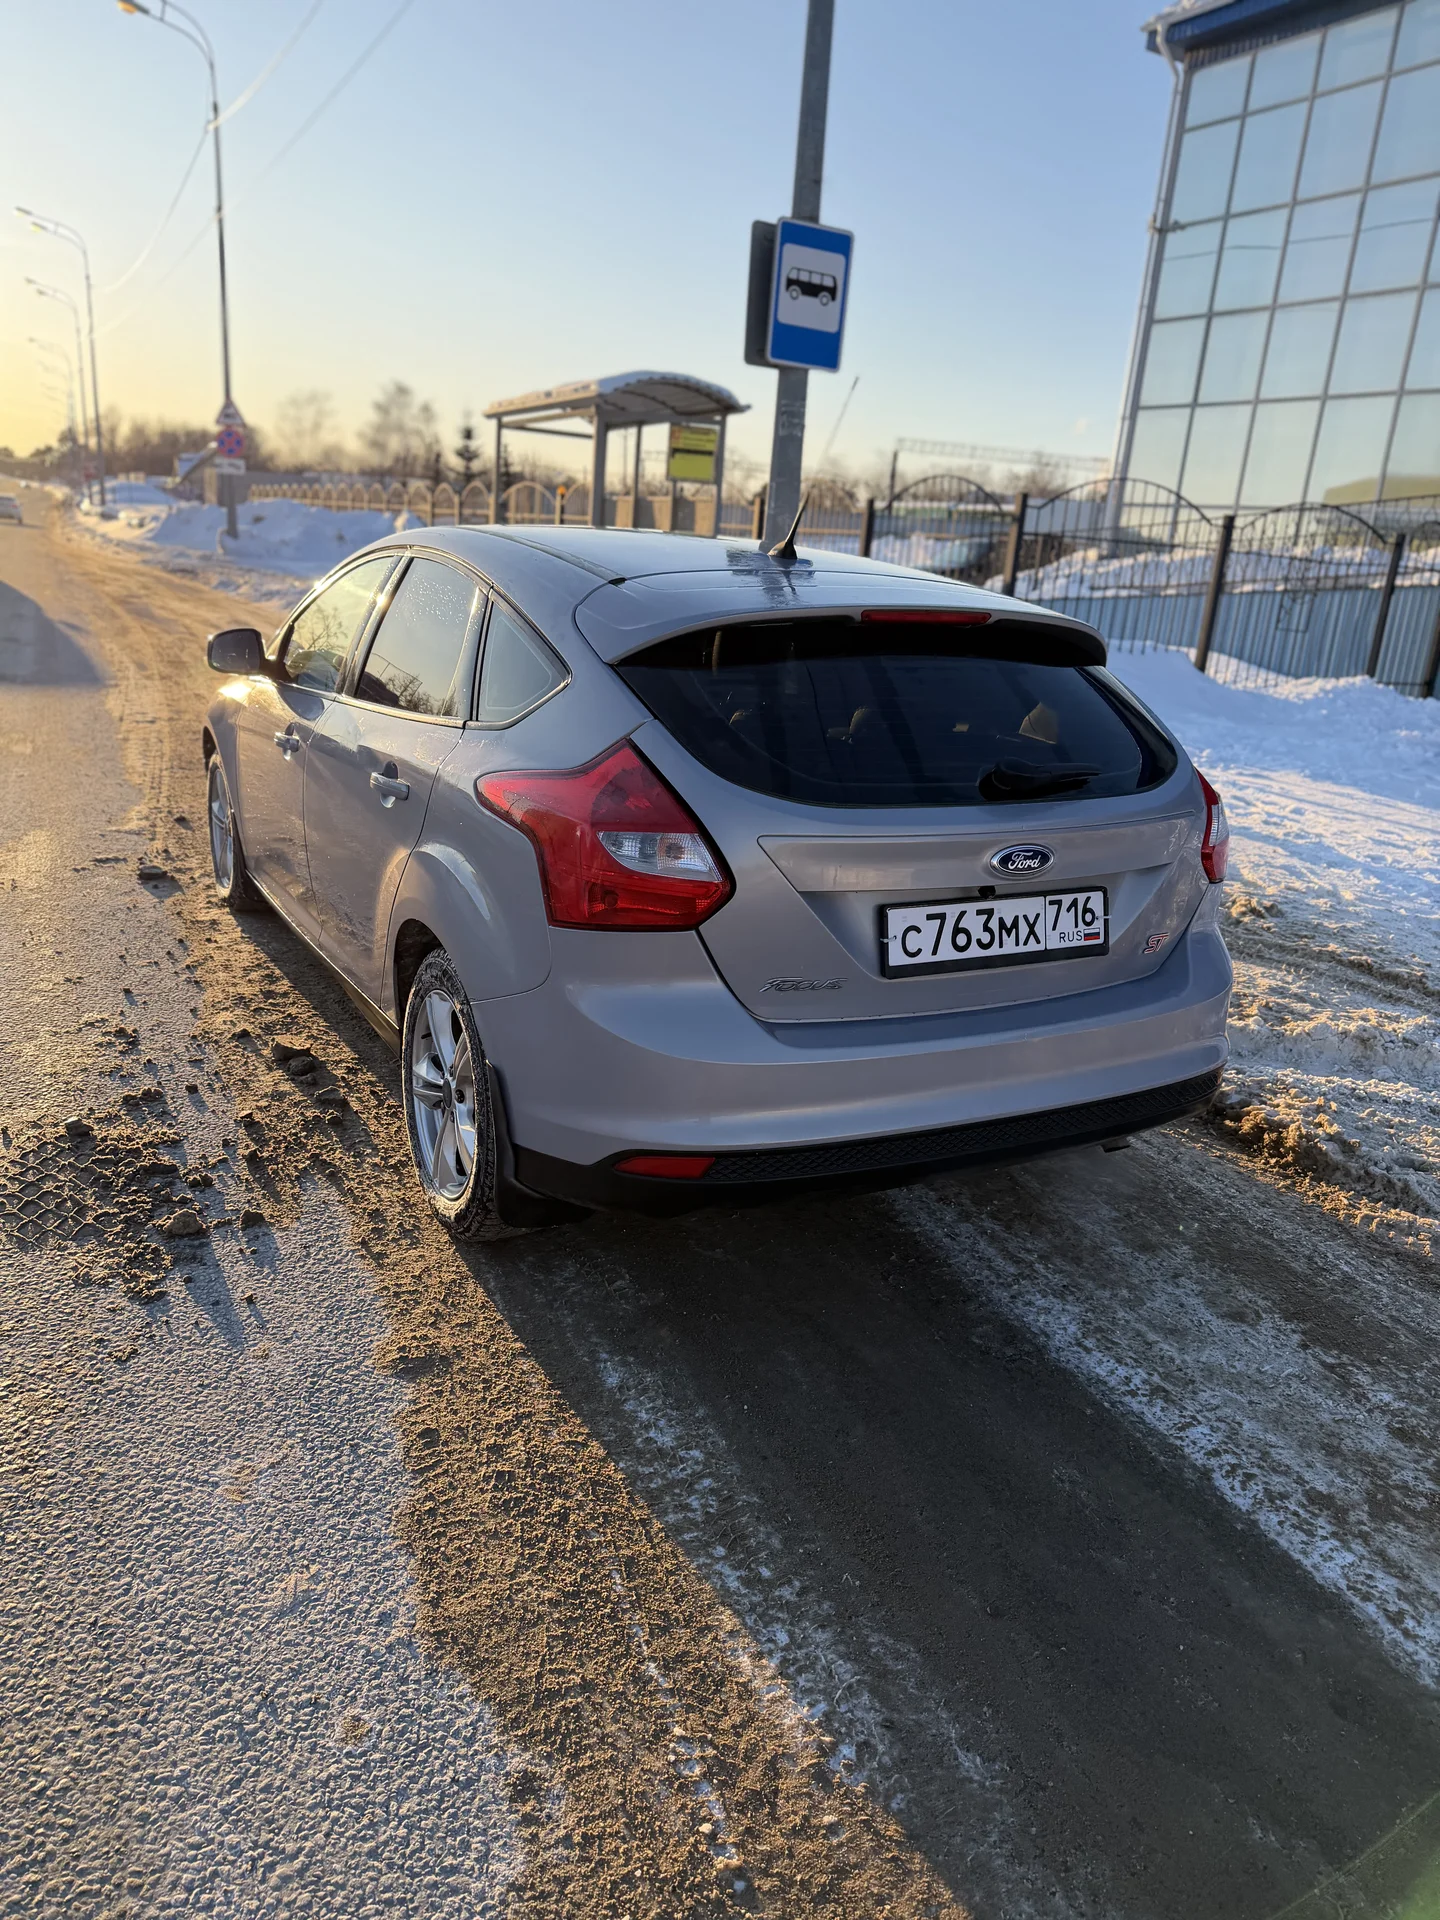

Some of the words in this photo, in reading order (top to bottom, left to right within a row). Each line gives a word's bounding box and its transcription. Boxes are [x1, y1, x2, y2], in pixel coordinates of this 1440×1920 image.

[1008, 851, 1041, 869] Ford
[1048, 895, 1096, 931] 716
[1059, 931, 1083, 943] RUS
[1143, 932, 1169, 954] ST
